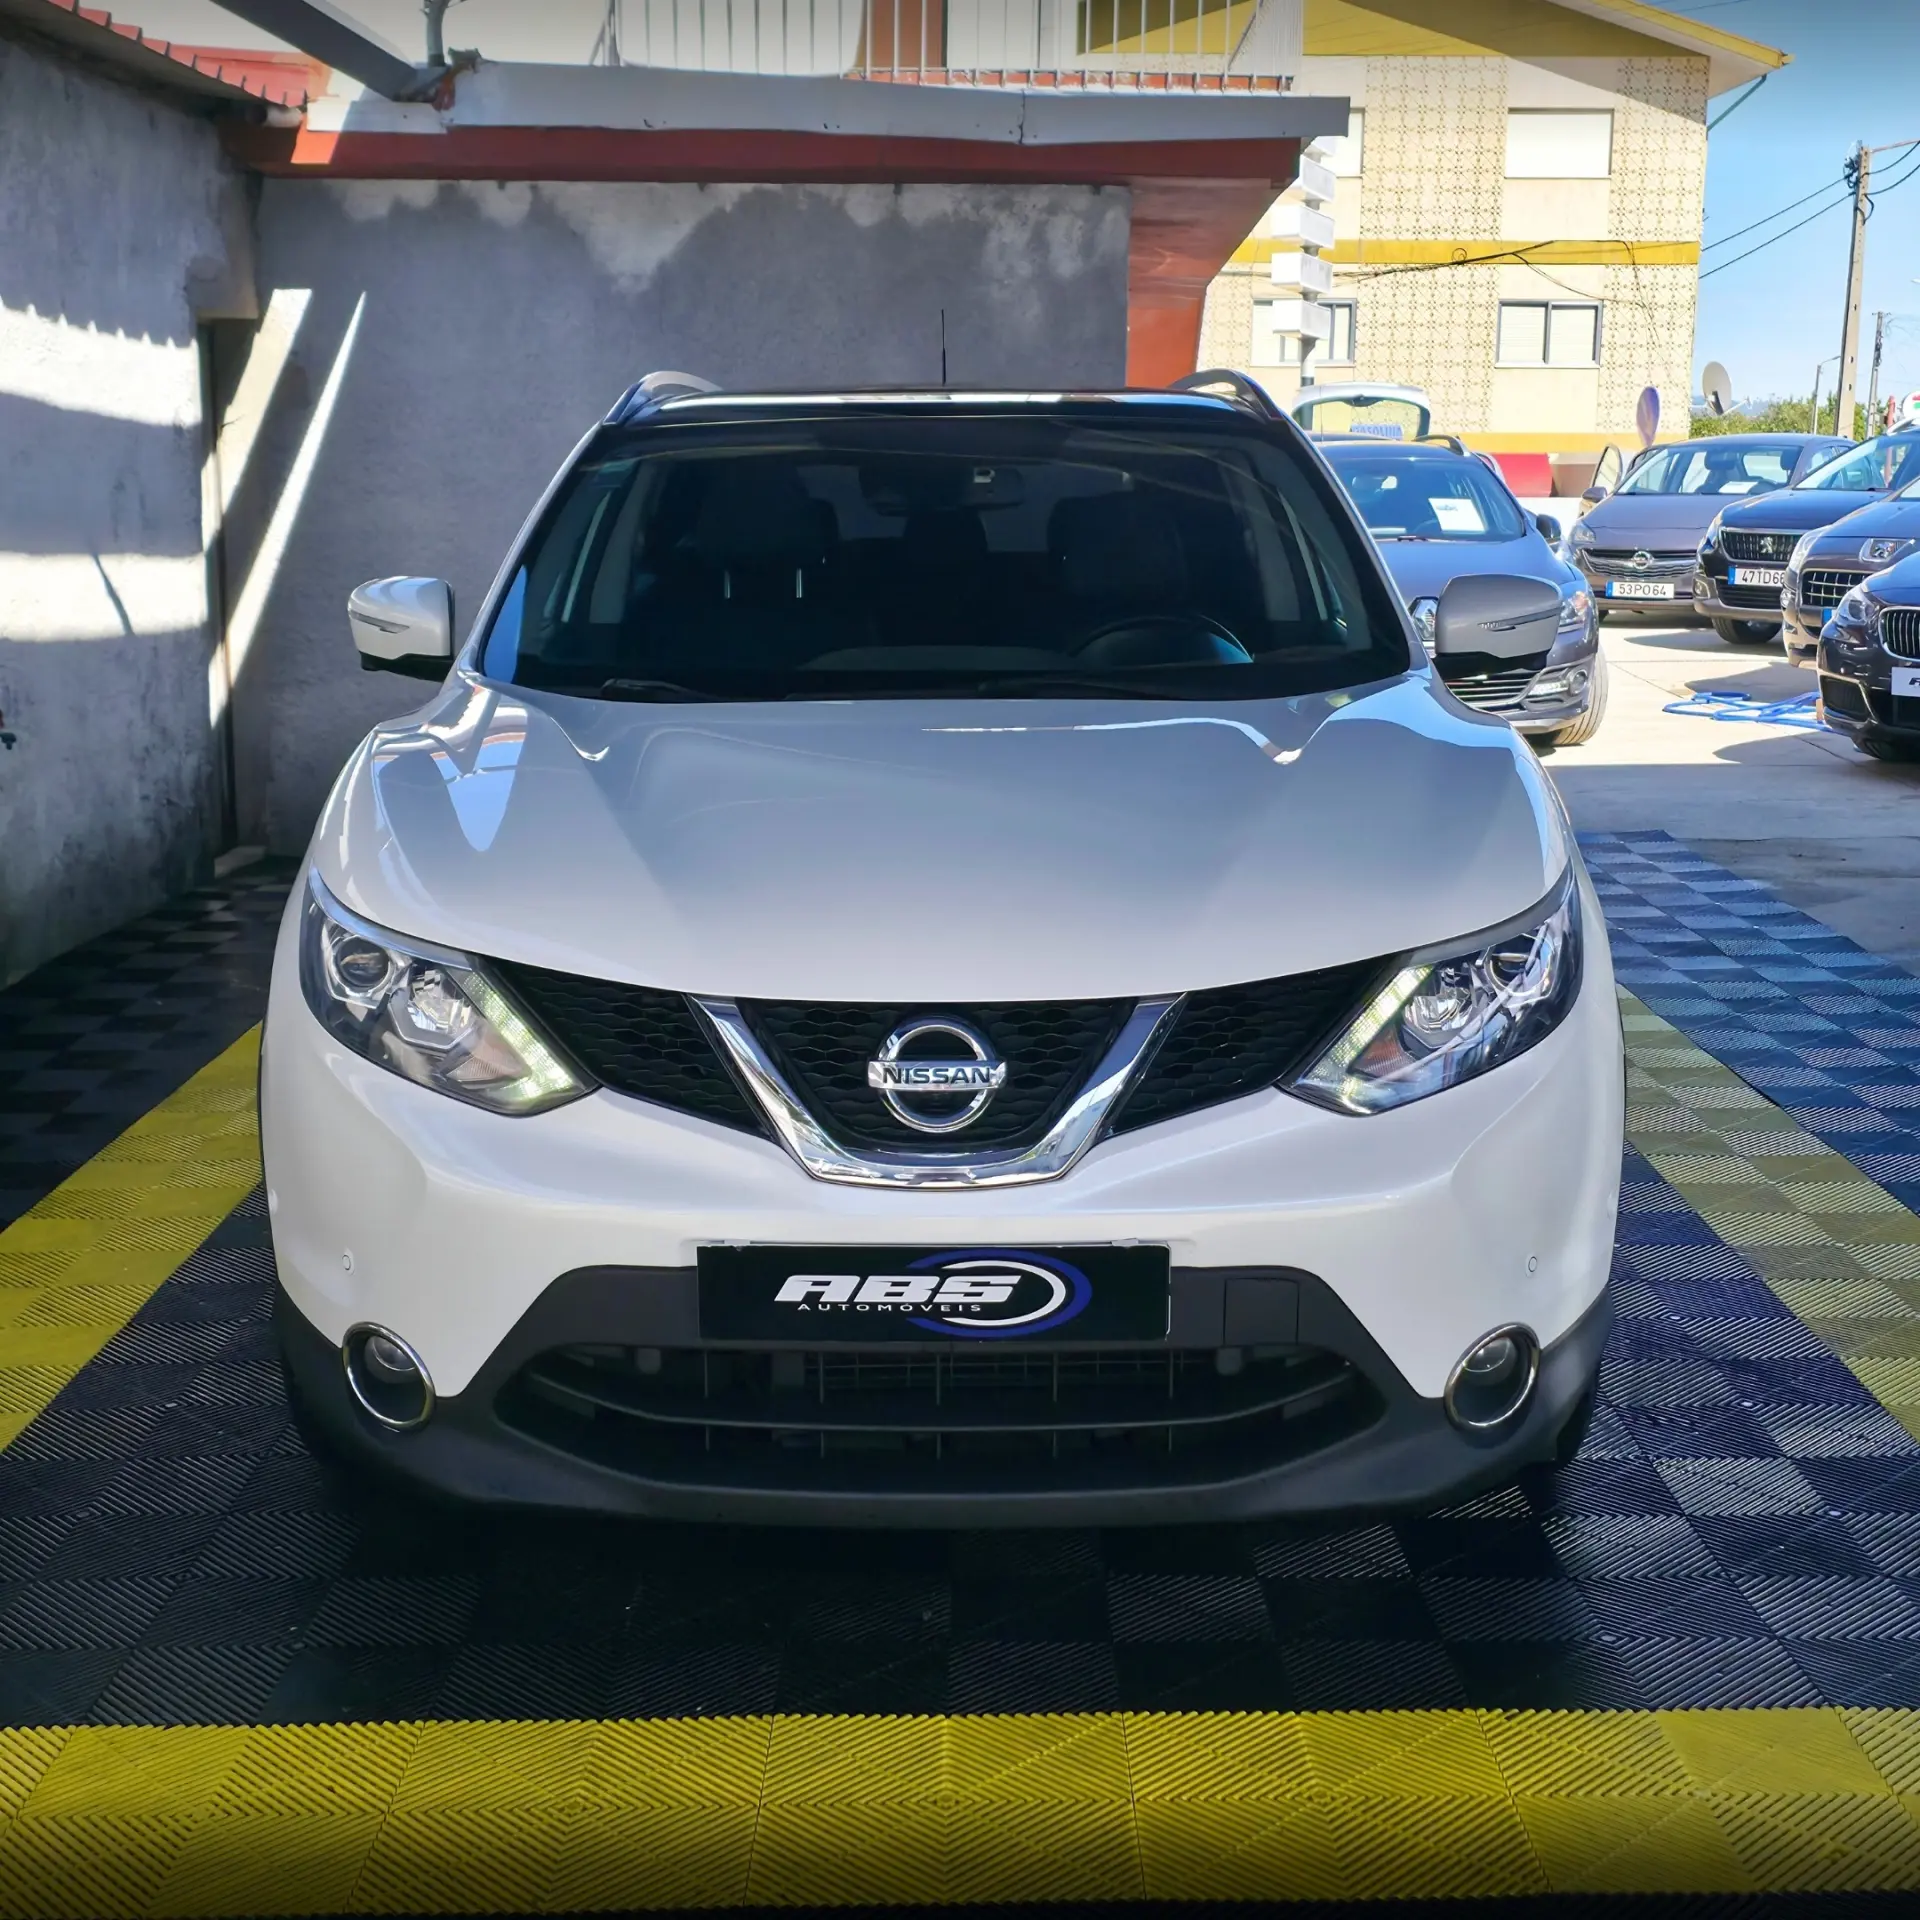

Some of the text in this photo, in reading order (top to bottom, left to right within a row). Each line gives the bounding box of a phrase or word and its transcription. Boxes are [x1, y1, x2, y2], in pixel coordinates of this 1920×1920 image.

[882, 1067, 990, 1084] NISSAN
[774, 1275, 1021, 1303] ABS
[798, 1303, 981, 1312] AUTOMÓVEIS
